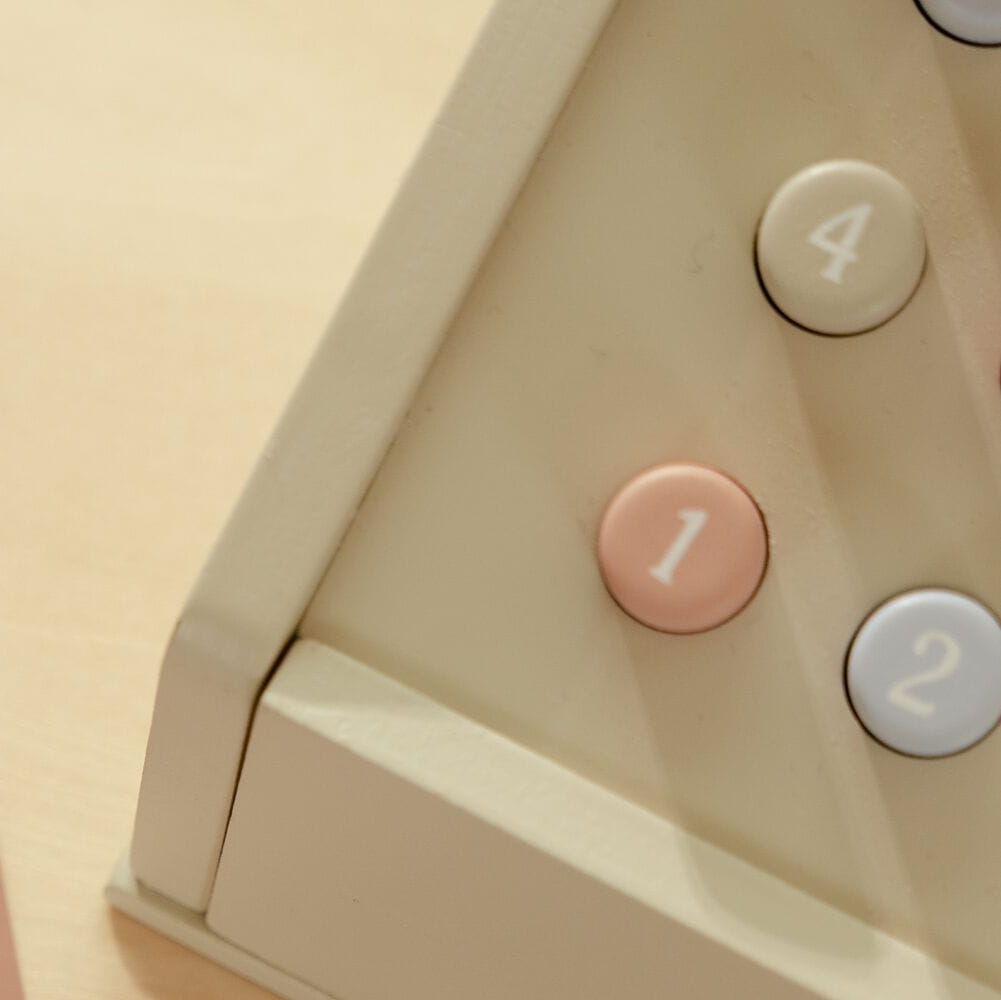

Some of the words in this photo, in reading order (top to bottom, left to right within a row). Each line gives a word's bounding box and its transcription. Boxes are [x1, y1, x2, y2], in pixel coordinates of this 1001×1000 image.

[808, 202, 875, 285] 4
[649, 508, 708, 586] 1
[887, 629, 962, 717] 2
